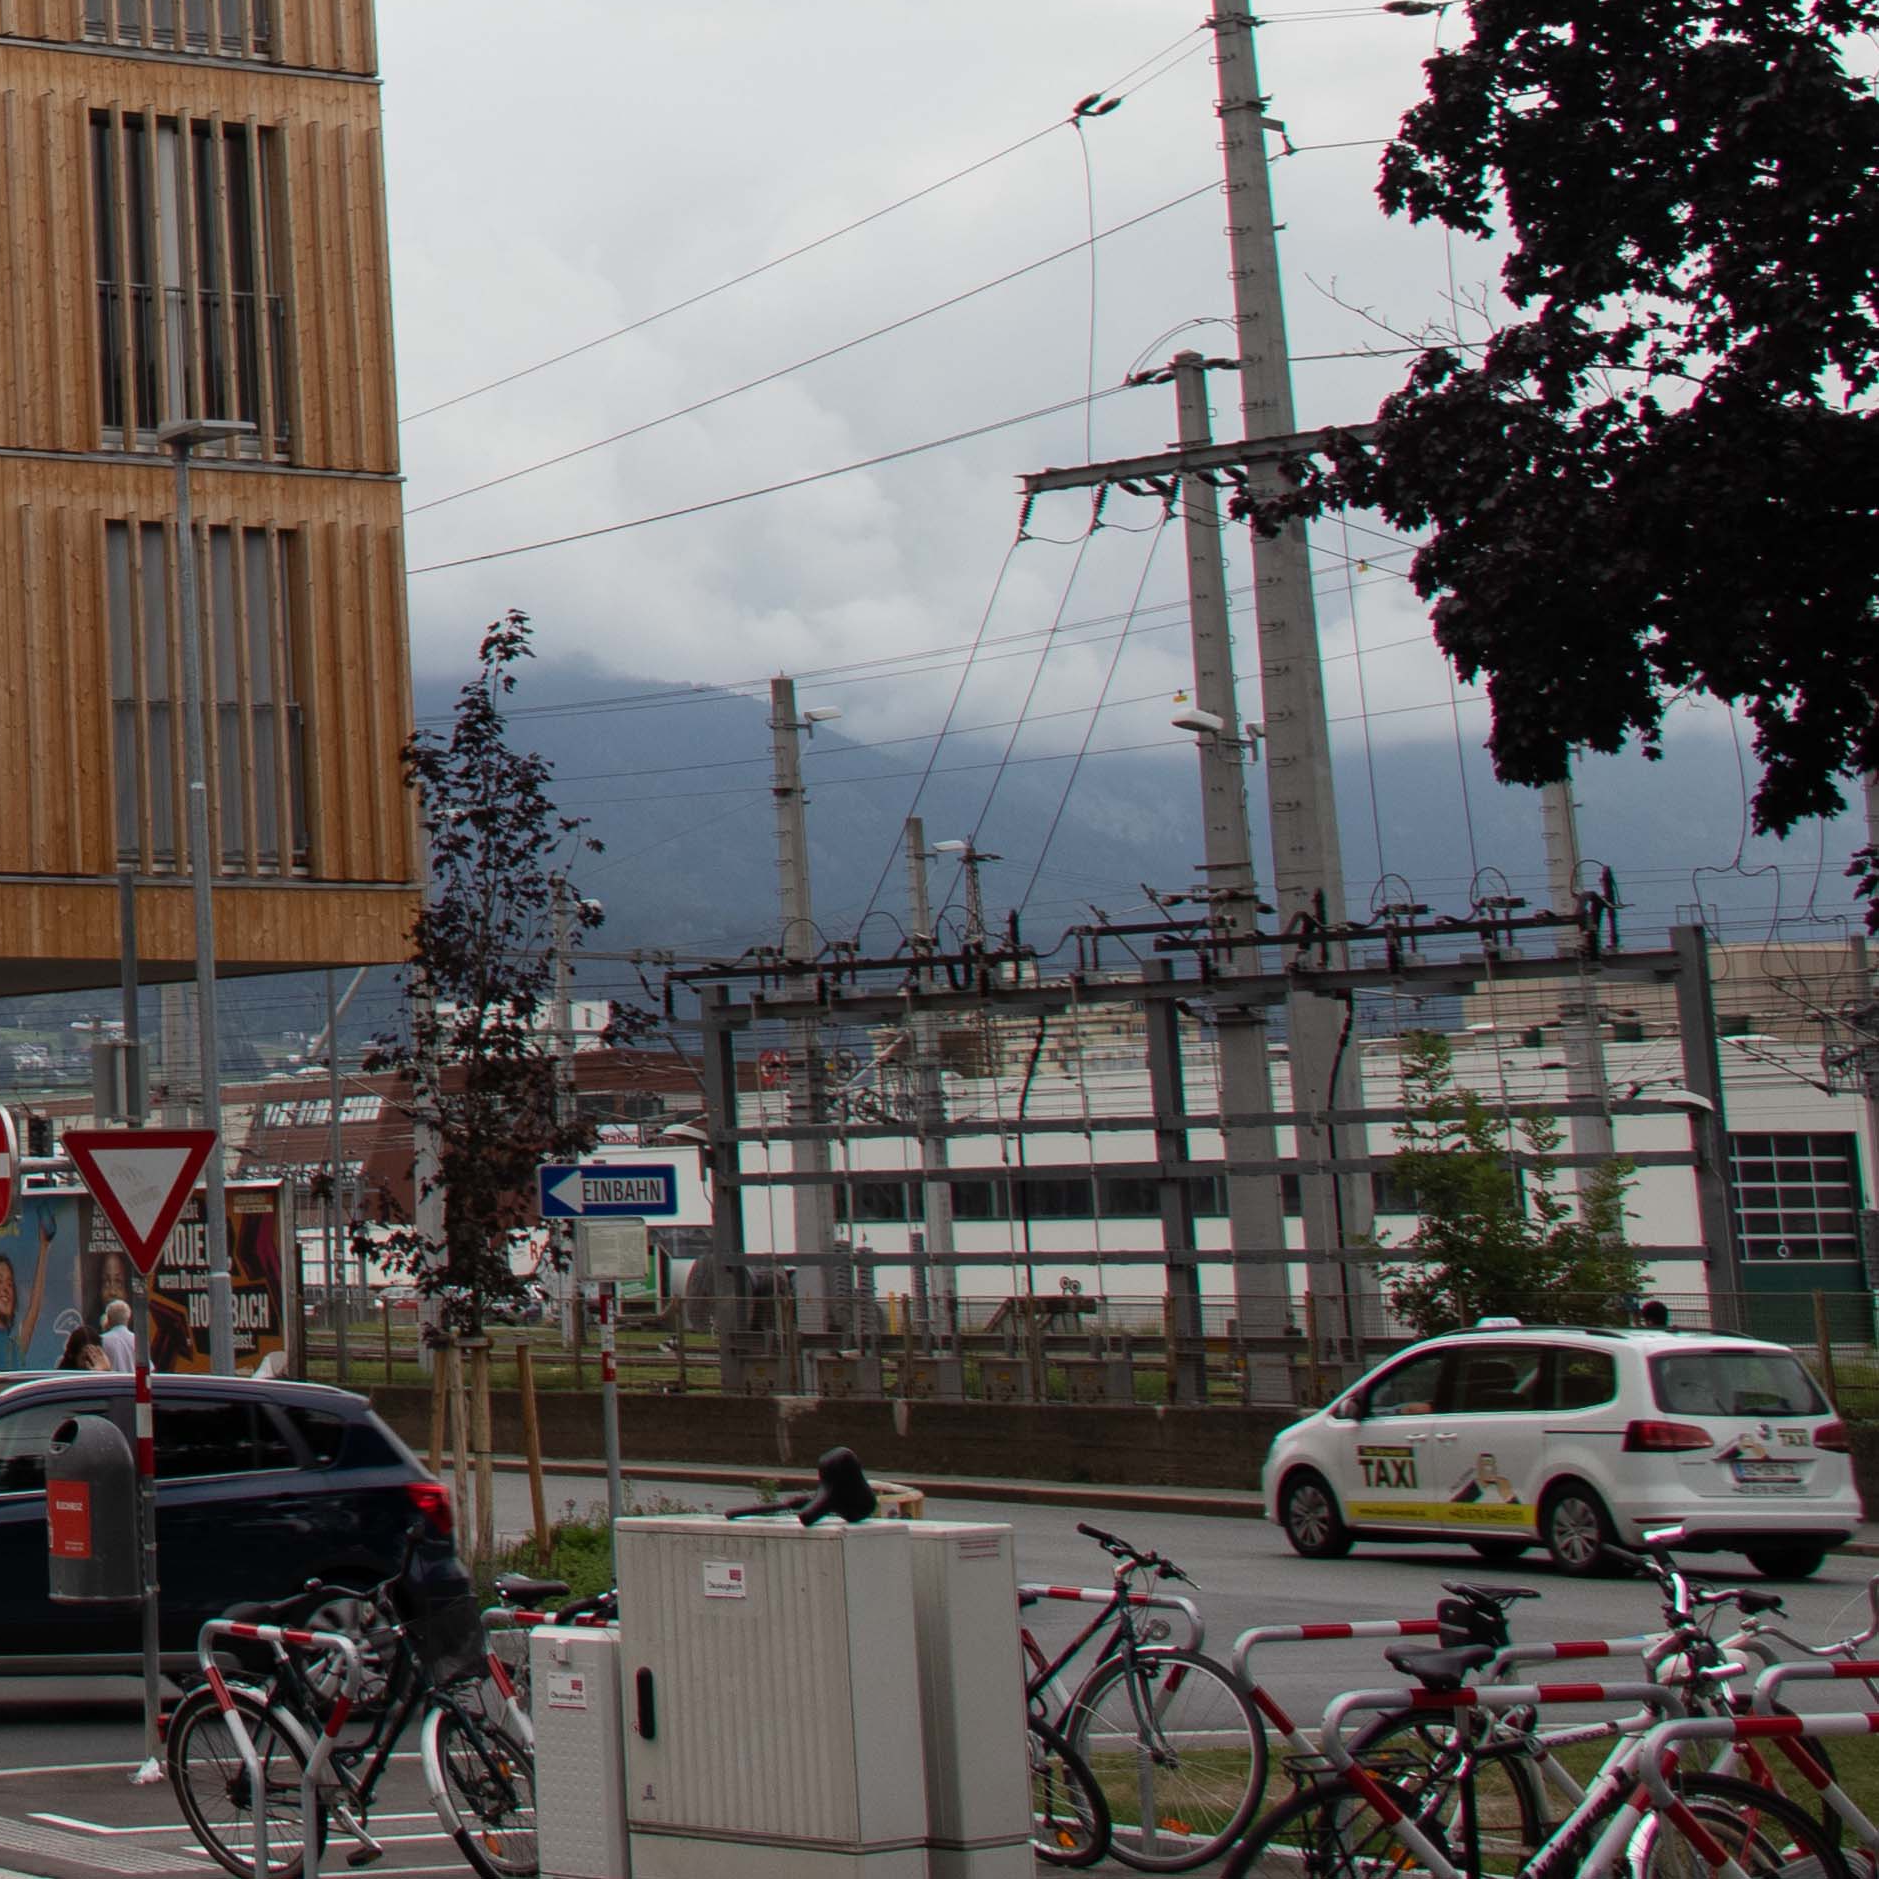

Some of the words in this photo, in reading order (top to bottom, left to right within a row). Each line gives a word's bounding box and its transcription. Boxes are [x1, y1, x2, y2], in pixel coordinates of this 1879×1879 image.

[583, 1180, 660, 1202] EINBAHN
[189, 1293, 269, 1328] HOBACH
[1358, 1459, 1417, 1489] TAXI
